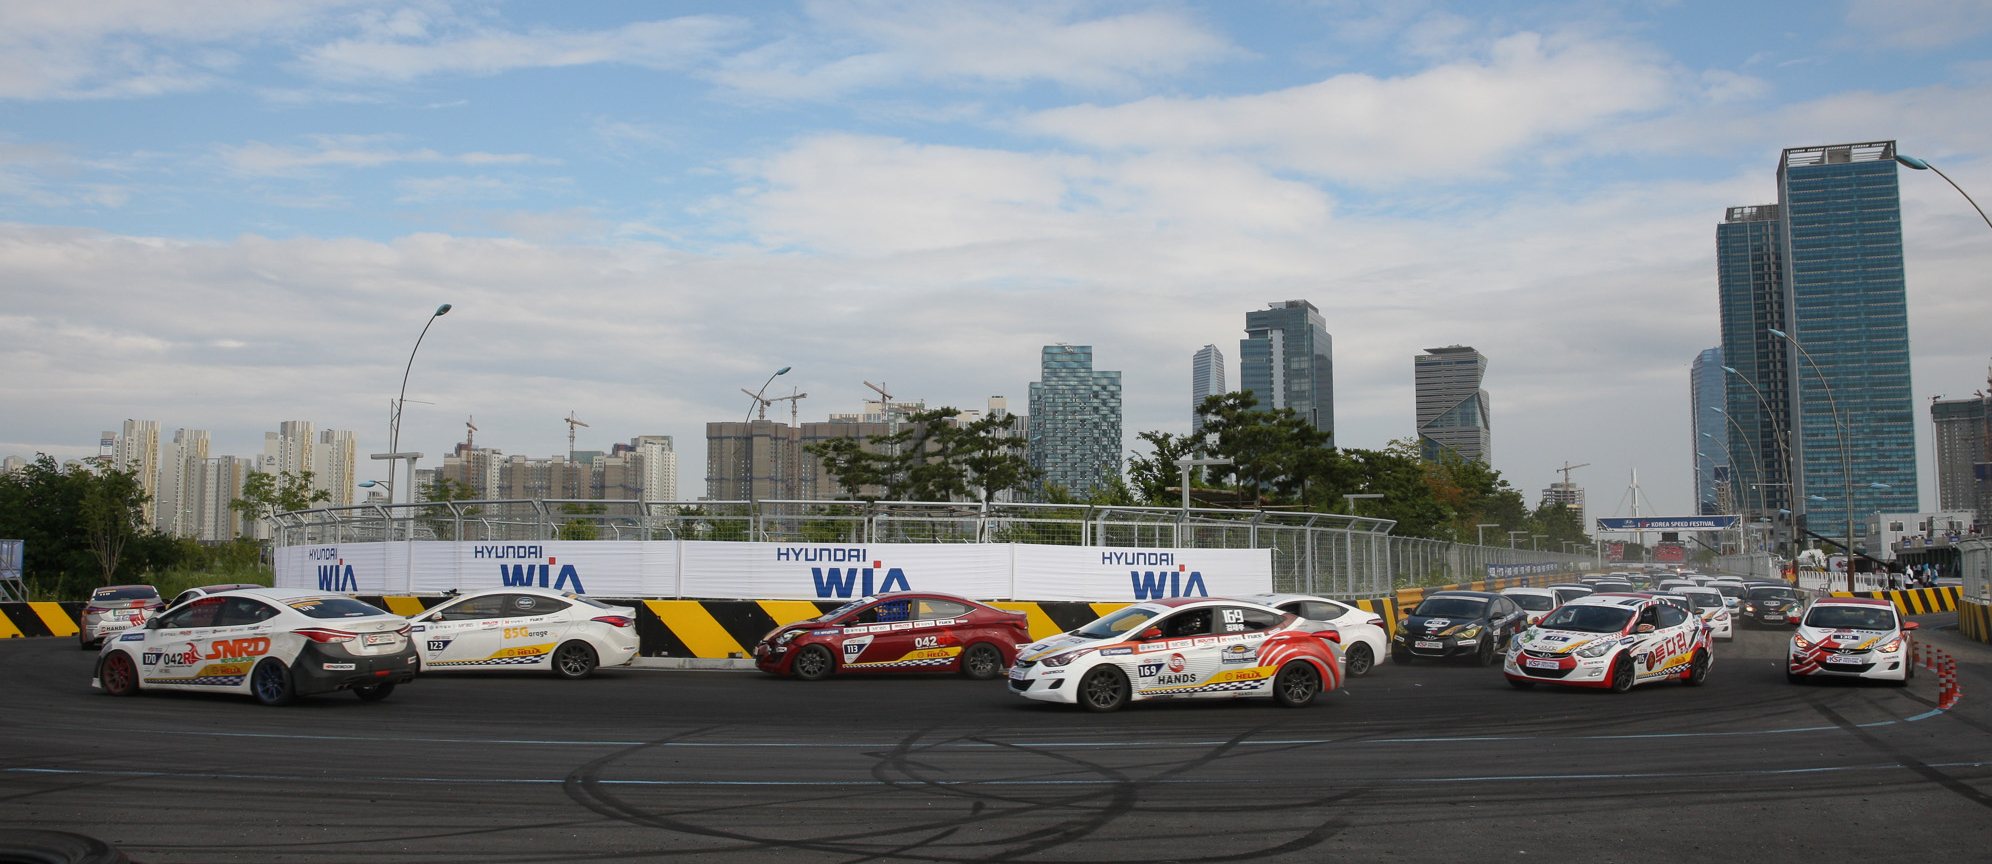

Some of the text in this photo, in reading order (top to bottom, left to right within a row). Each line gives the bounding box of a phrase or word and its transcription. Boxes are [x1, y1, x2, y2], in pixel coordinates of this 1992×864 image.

[309, 548, 338, 560] HYUNDAI
[474, 545, 543, 559] HYUNDAI
[777, 548, 867, 562] HYUNDAI
[1102, 552, 1174, 566] HYUNDAI
[318, 565, 358, 592] WIA
[500, 564, 586, 594] WIA
[811, 567, 912, 598] WIA
[1130, 571, 1208, 600] WIA
[1222, 609, 1245, 623] 169
[205, 637, 271, 660] SNRD
[429, 641, 444, 650] 123
[518, 648, 542, 656] HELIX
[846, 645, 859, 653] 113
[1655, 631, 1687, 665] 투다리
[144, 653, 156, 664] 170
[1139, 665, 1157, 677] 169
[1236, 671, 1262, 680] HELIX
[1158, 673, 1197, 685] HANDS
